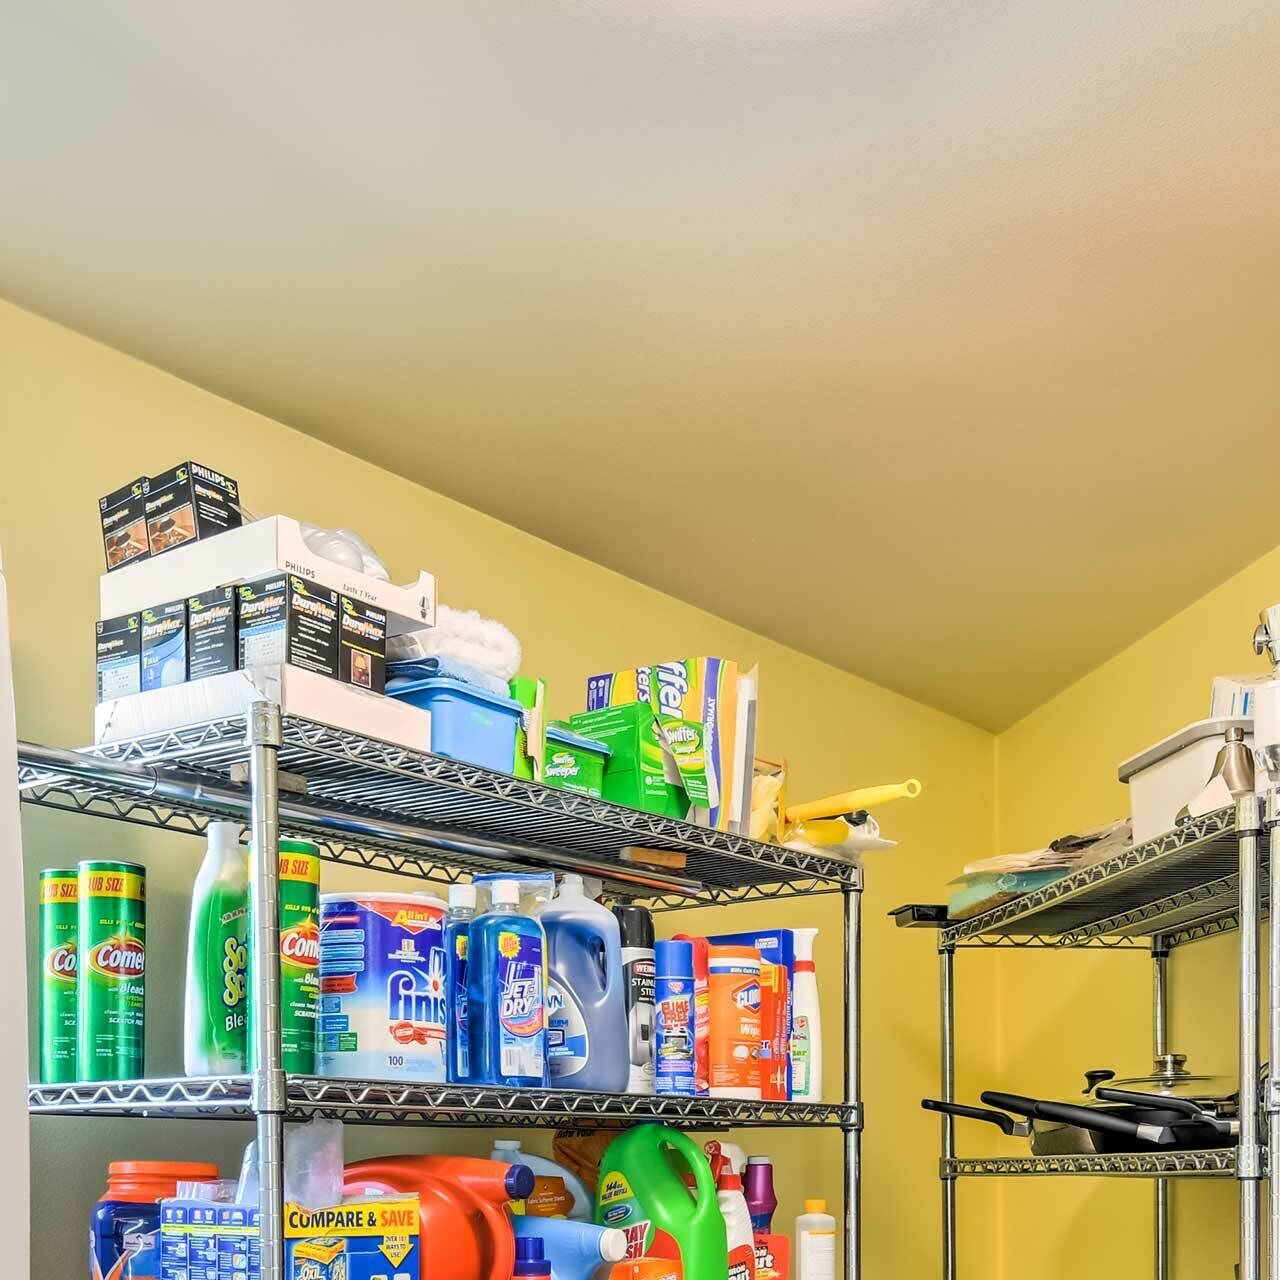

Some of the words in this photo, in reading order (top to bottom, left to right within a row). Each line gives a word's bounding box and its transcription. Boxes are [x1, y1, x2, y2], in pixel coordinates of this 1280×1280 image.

[192, 464, 225, 485] PHILIPS
[286, 561, 315, 579] PHILIPS
[545, 765, 580, 778] Sweeper
[107, 878, 124, 892] SIZE
[388, 1056, 403, 1065] 100
[289, 1211, 363, 1228] COMPARE
[367, 1212, 376, 1227] &
[381, 1210, 414, 1226] SAVE
